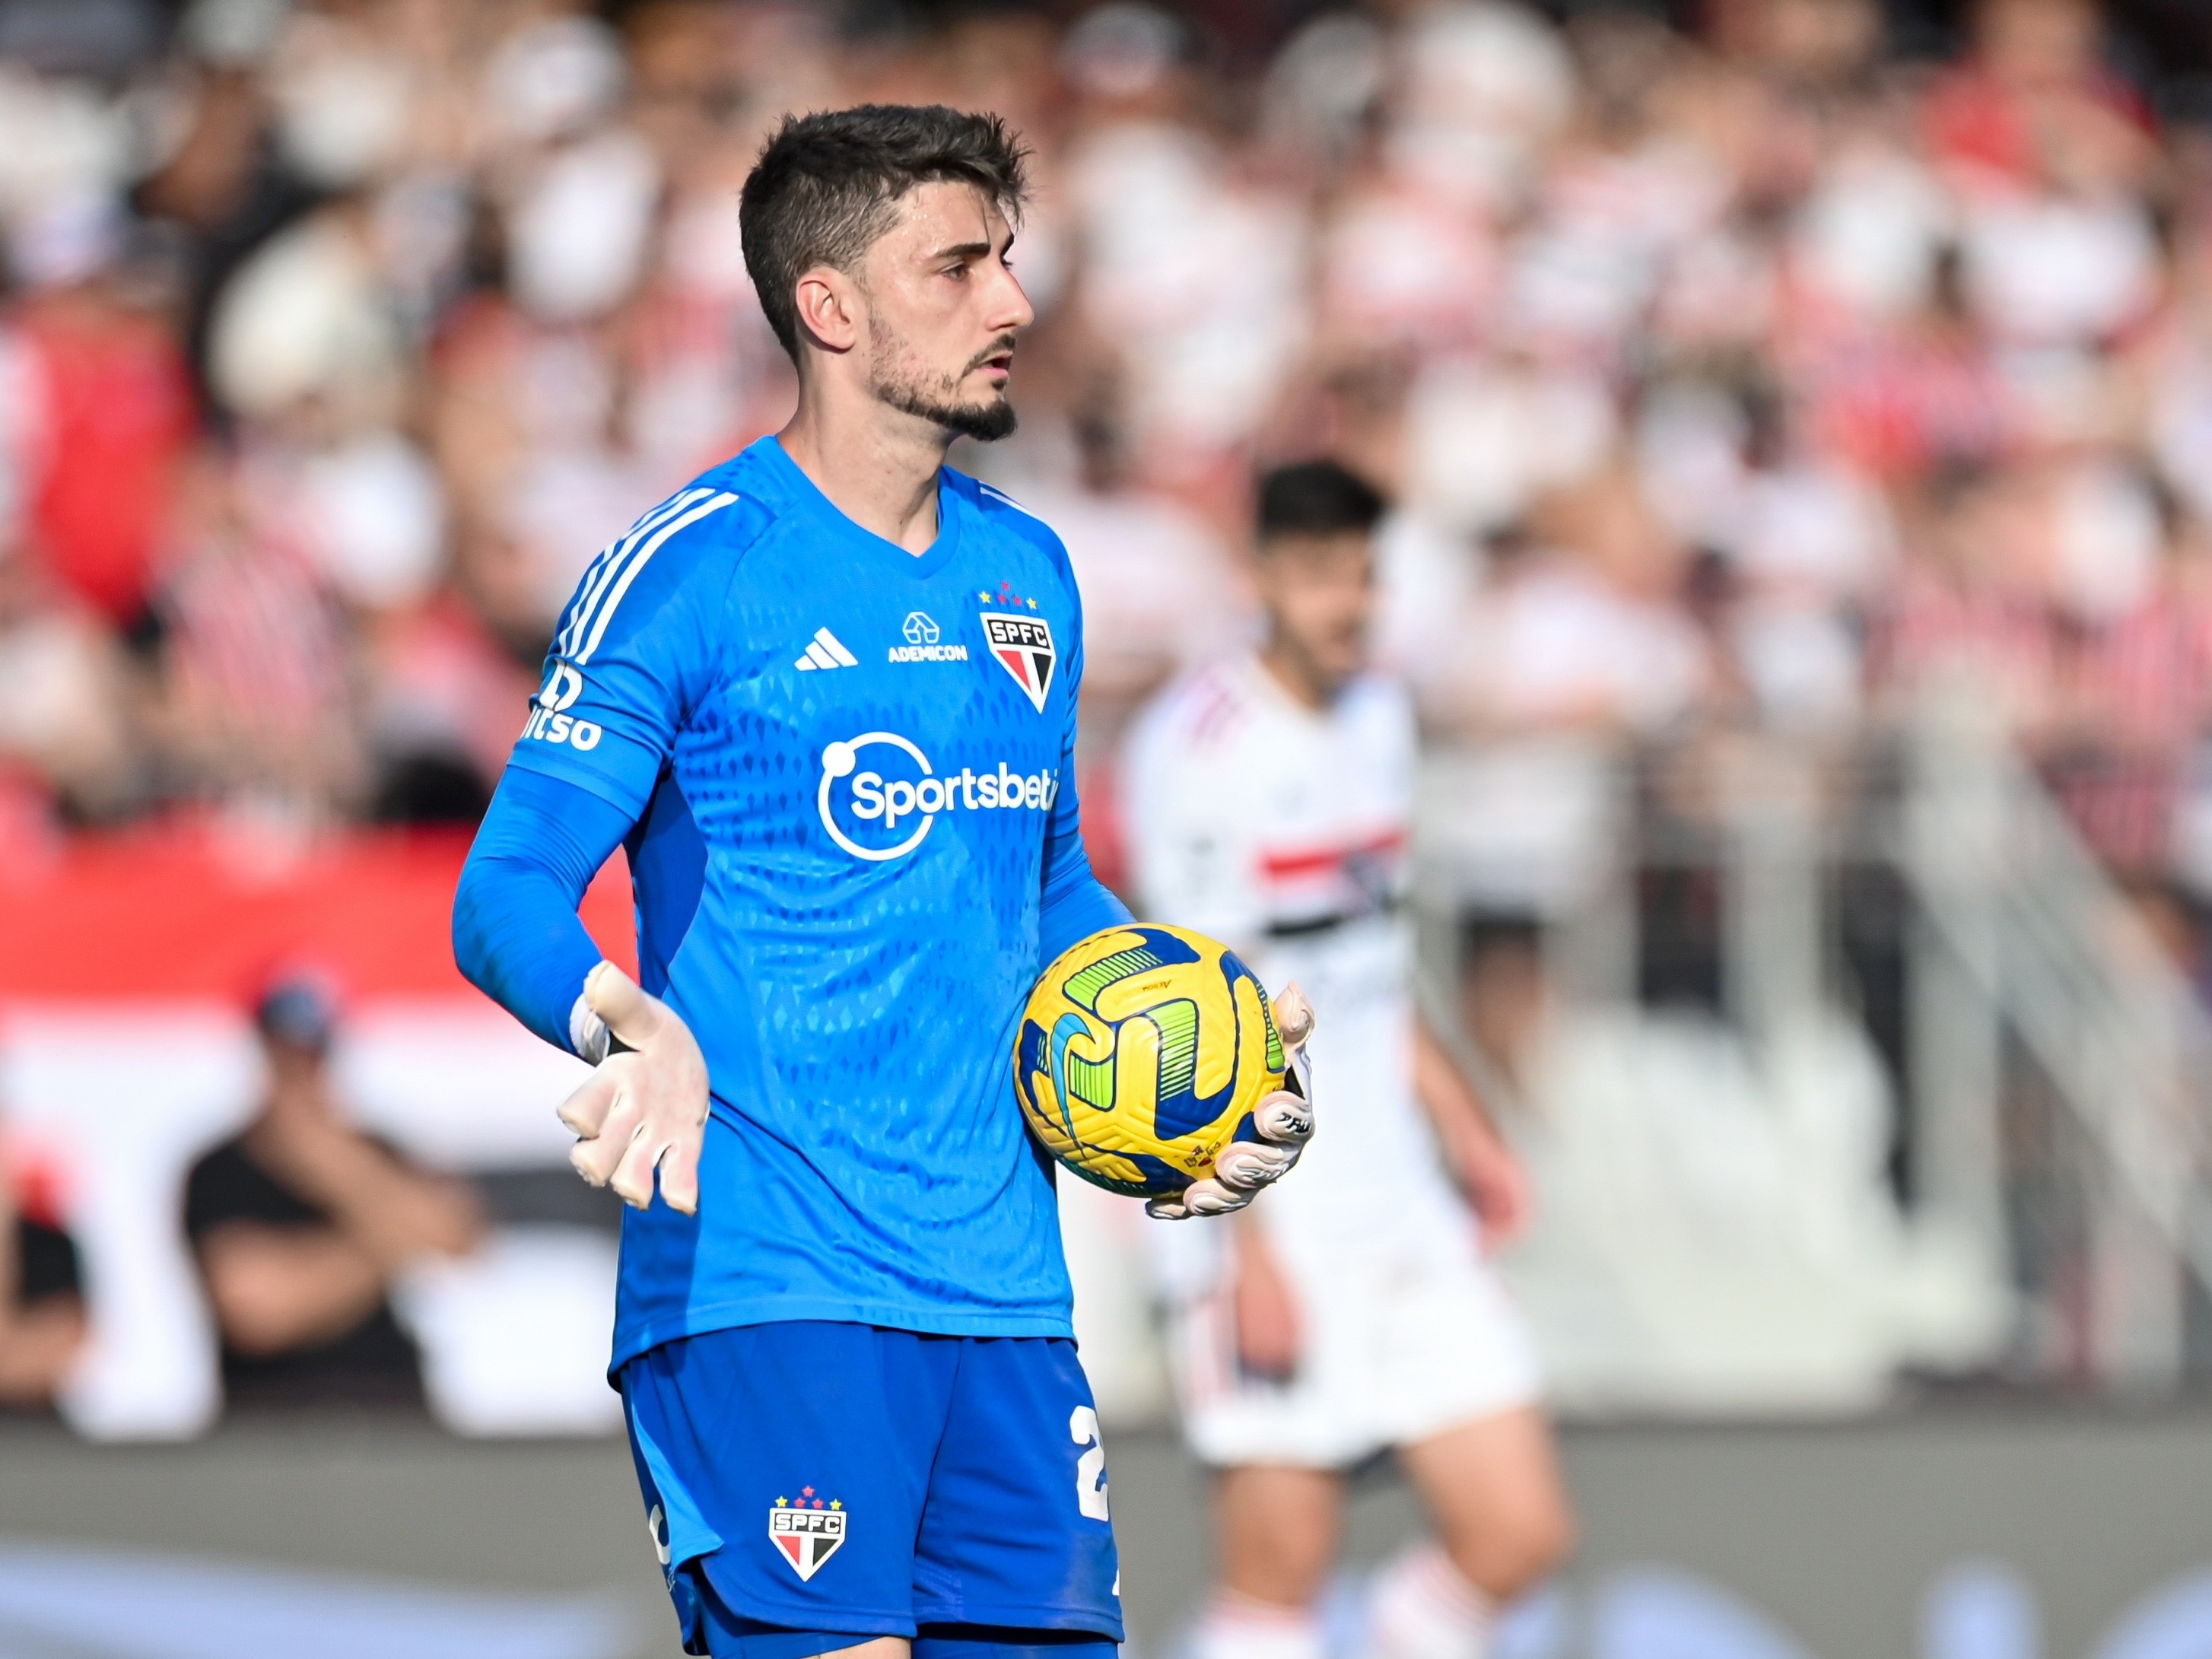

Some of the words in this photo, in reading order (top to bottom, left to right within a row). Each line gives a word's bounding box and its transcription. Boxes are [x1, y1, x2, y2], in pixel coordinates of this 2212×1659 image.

[990, 621, 1047, 647] SPFC
[888, 645, 968, 663] ADEMICON
[520, 704, 602, 751] itso
[850, 761, 1060, 828] Sportsbeti
[774, 1514, 841, 1534] SPFC
